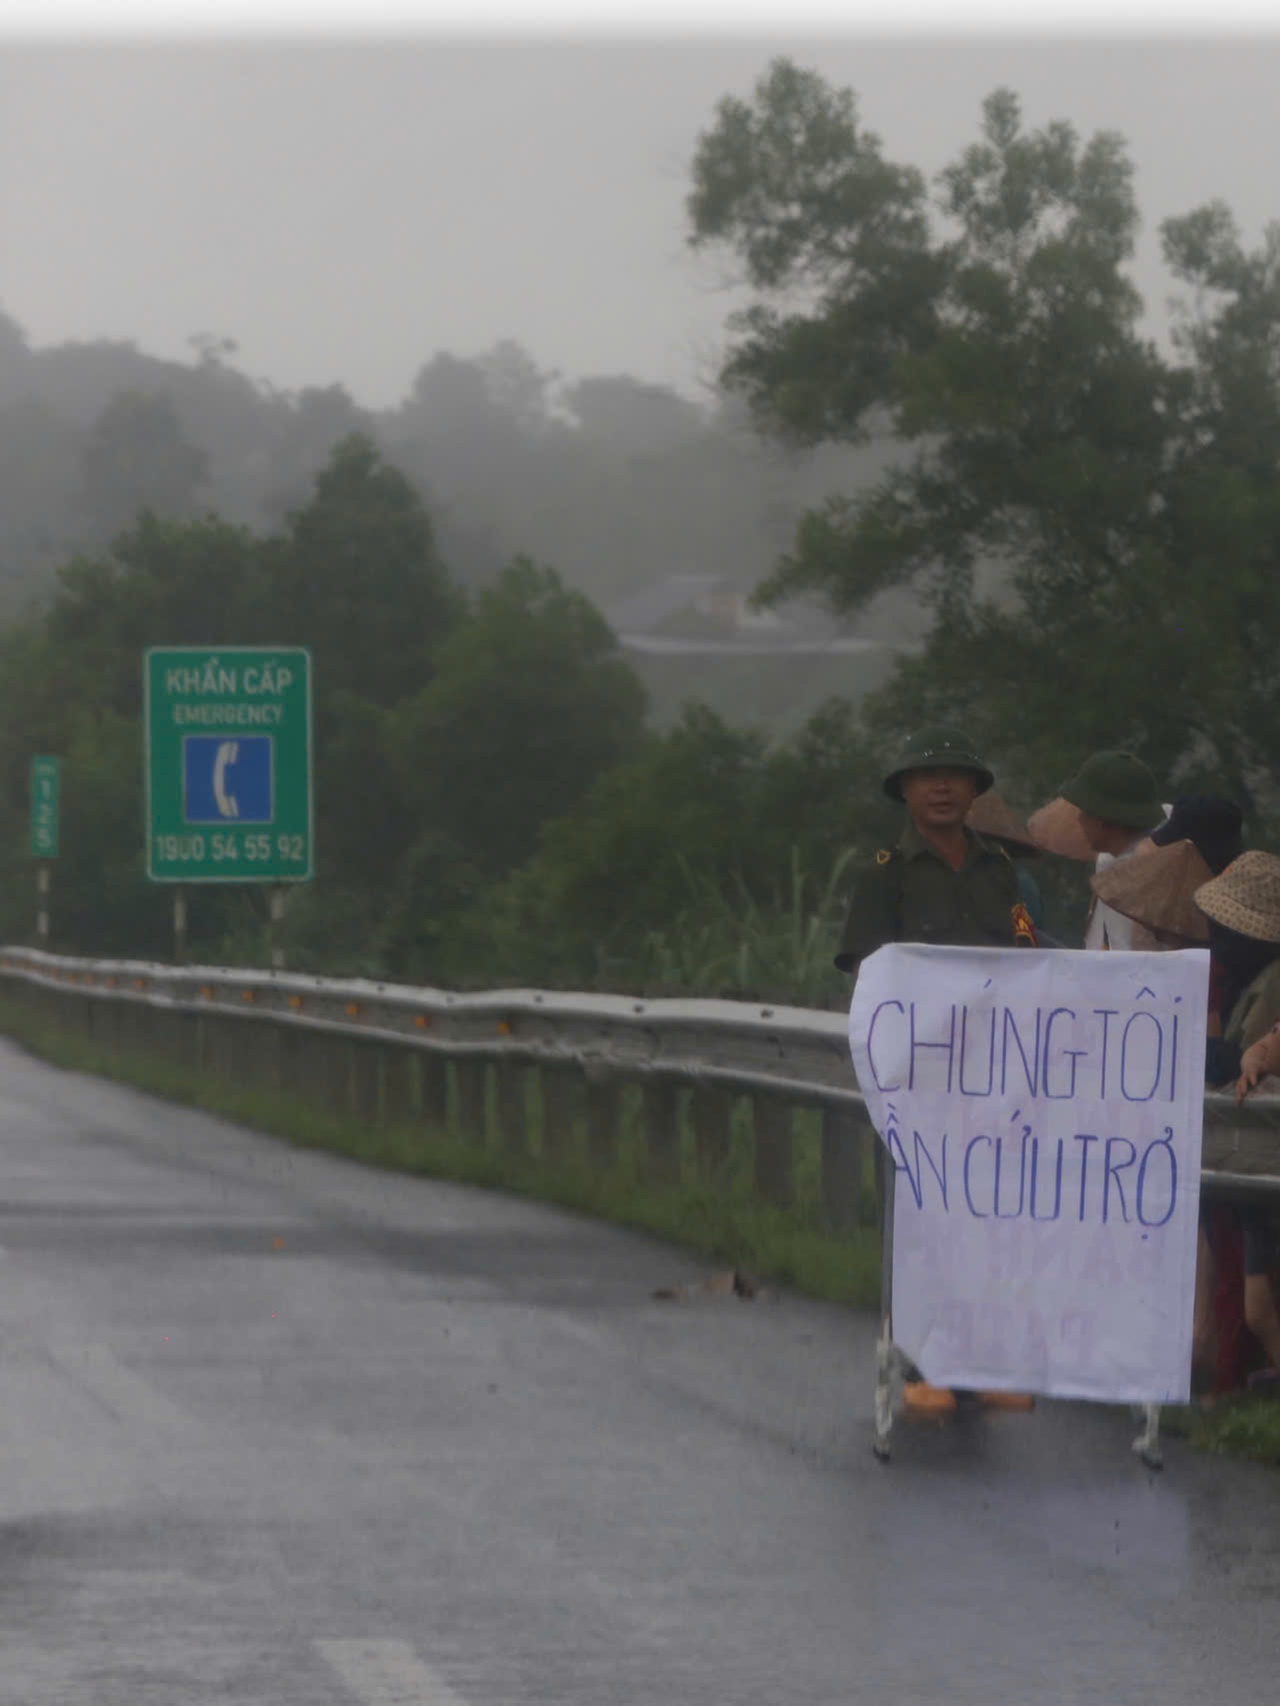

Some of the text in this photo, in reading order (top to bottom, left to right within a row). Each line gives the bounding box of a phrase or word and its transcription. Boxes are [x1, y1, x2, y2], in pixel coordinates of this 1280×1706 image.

[166, 656, 293, 694] KHẨN CẤP
[173, 703, 285, 725] EMERGENCY
[155, 834, 304, 861] 1900 54 55 92
[867, 978, 1088, 1099] CHÚNG
[882, 1103, 949, 1213] ẦN
[1073, 1126, 1178, 1240] TRỢ
